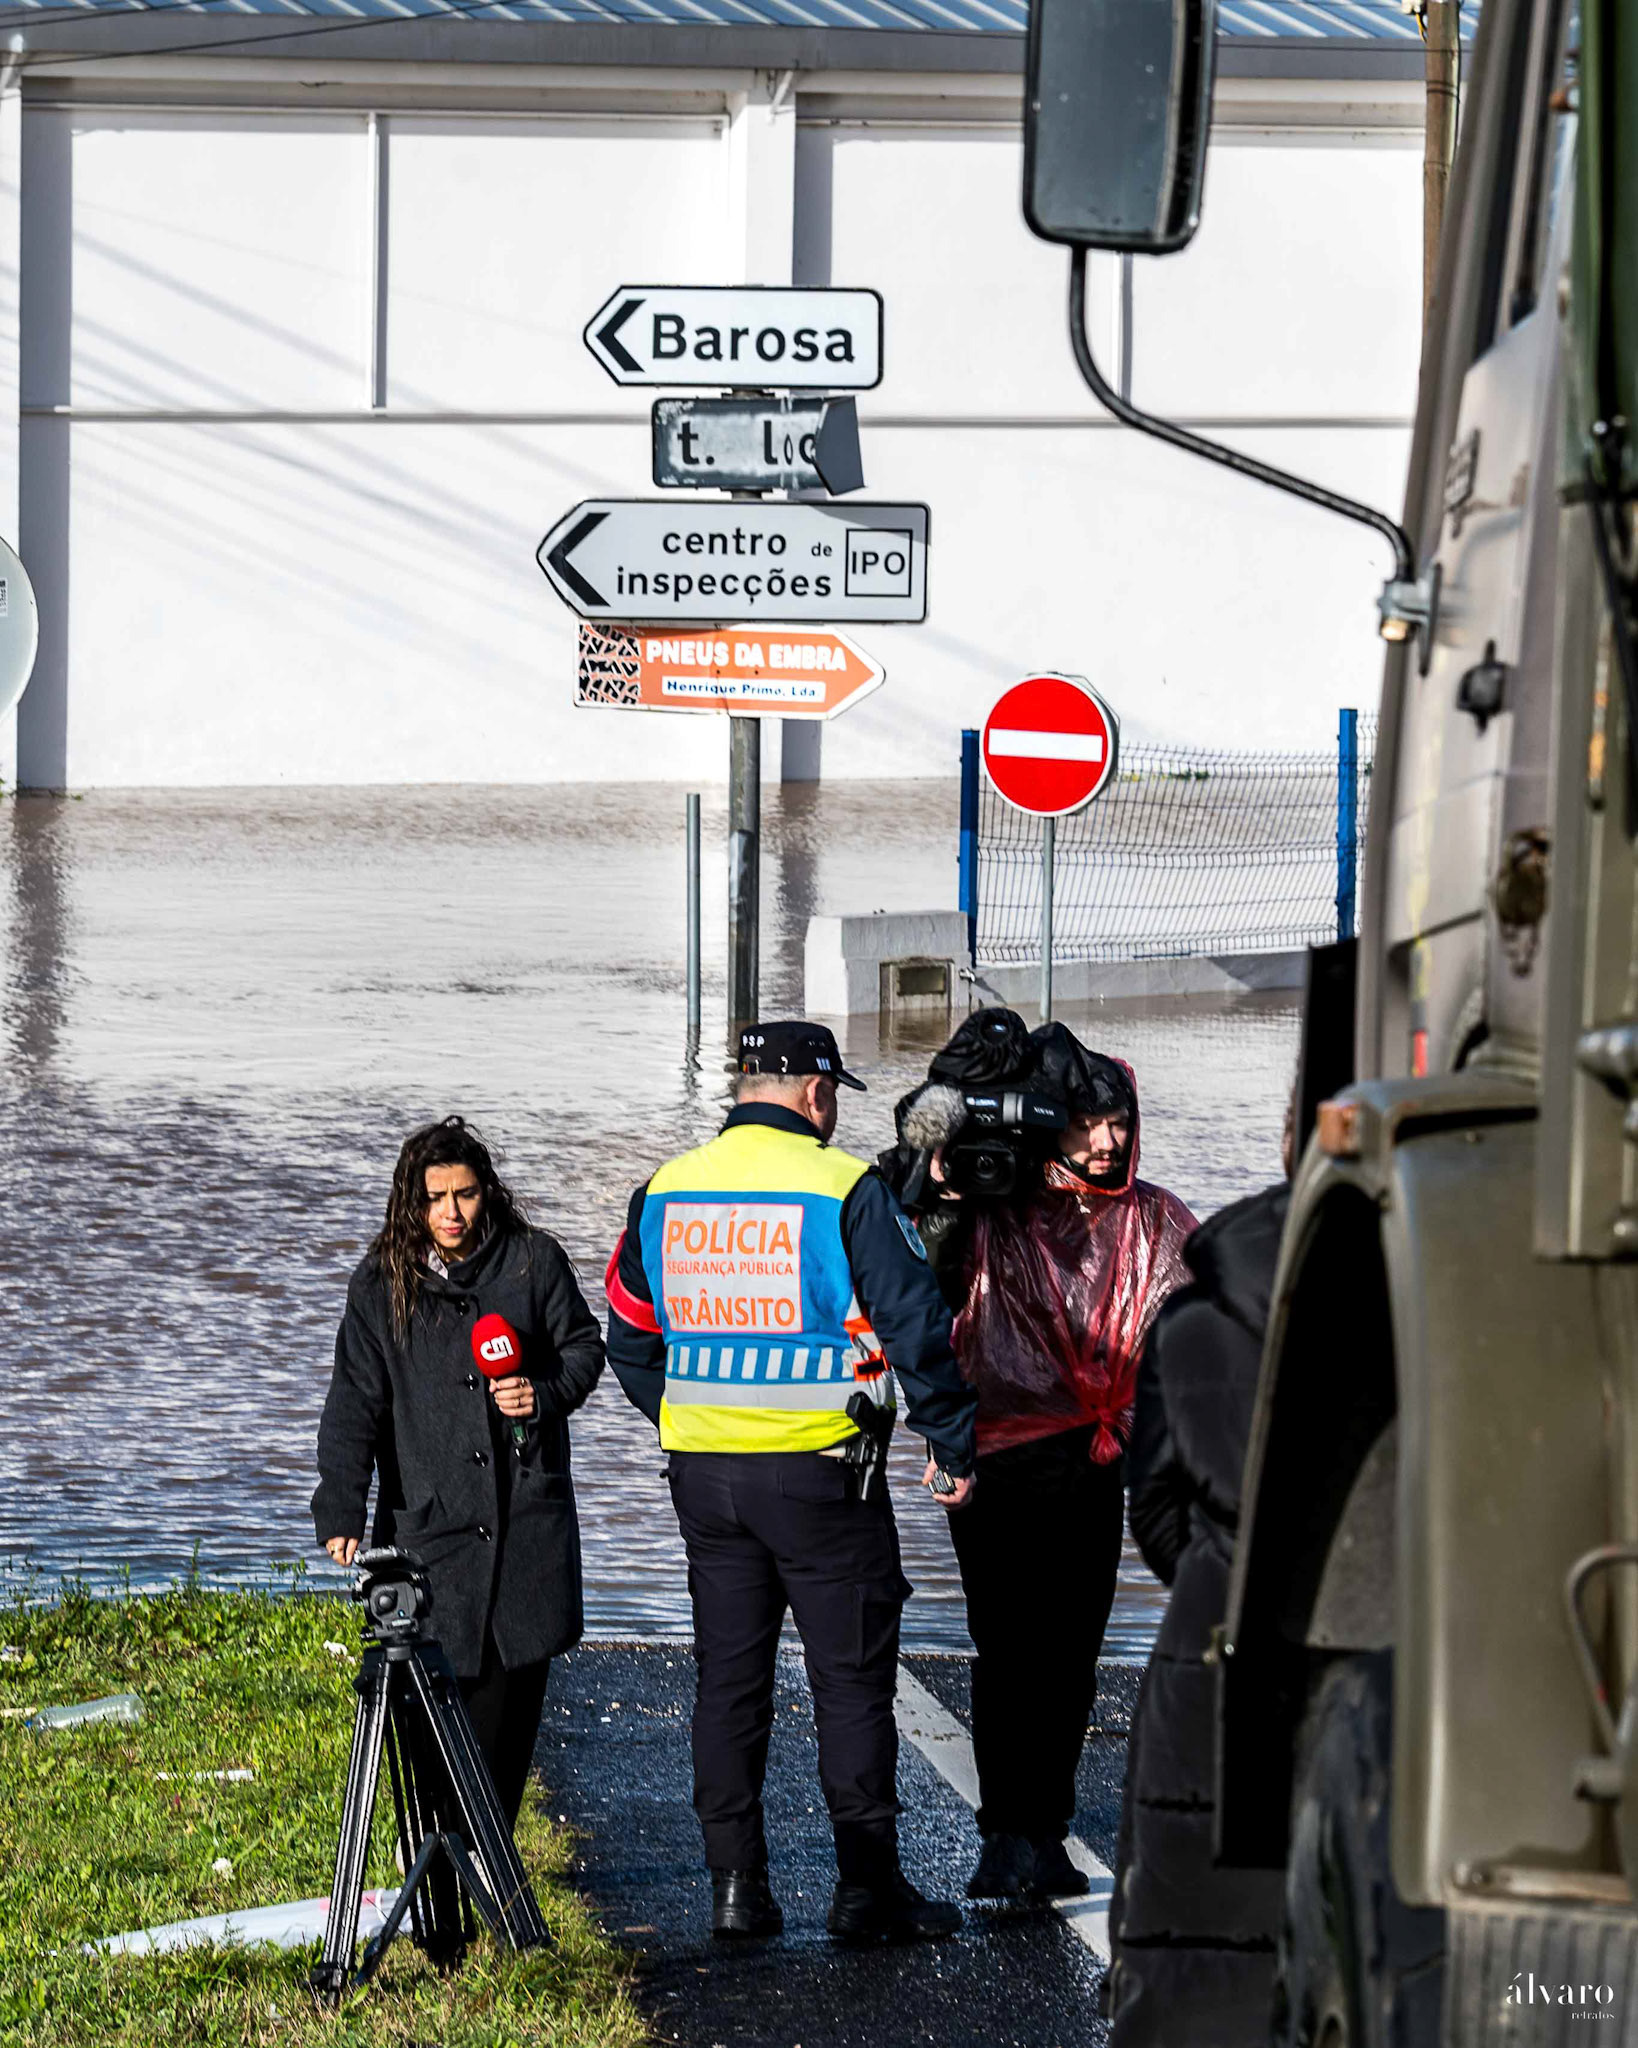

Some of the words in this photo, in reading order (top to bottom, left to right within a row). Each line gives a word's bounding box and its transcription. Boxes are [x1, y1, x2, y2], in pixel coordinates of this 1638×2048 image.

[652, 313, 855, 363] Barosa
[677, 420, 715, 465] t.
[662, 527, 787, 556] centro
[811, 542, 833, 557] de
[850, 550, 906, 576] IPO
[617, 566, 832, 606] inspecções
[646, 640, 729, 667] PNEUS
[734, 642, 766, 668] DA
[769, 644, 847, 672] EMBRA
[667, 681, 736, 695] Henrique
[742, 1034, 766, 1048] PSP
[666, 1209, 794, 1256] POLÍCIA
[667, 1260, 736, 1278] SEGURANÇA
[667, 1288, 796, 1327] TRÂNSITO
